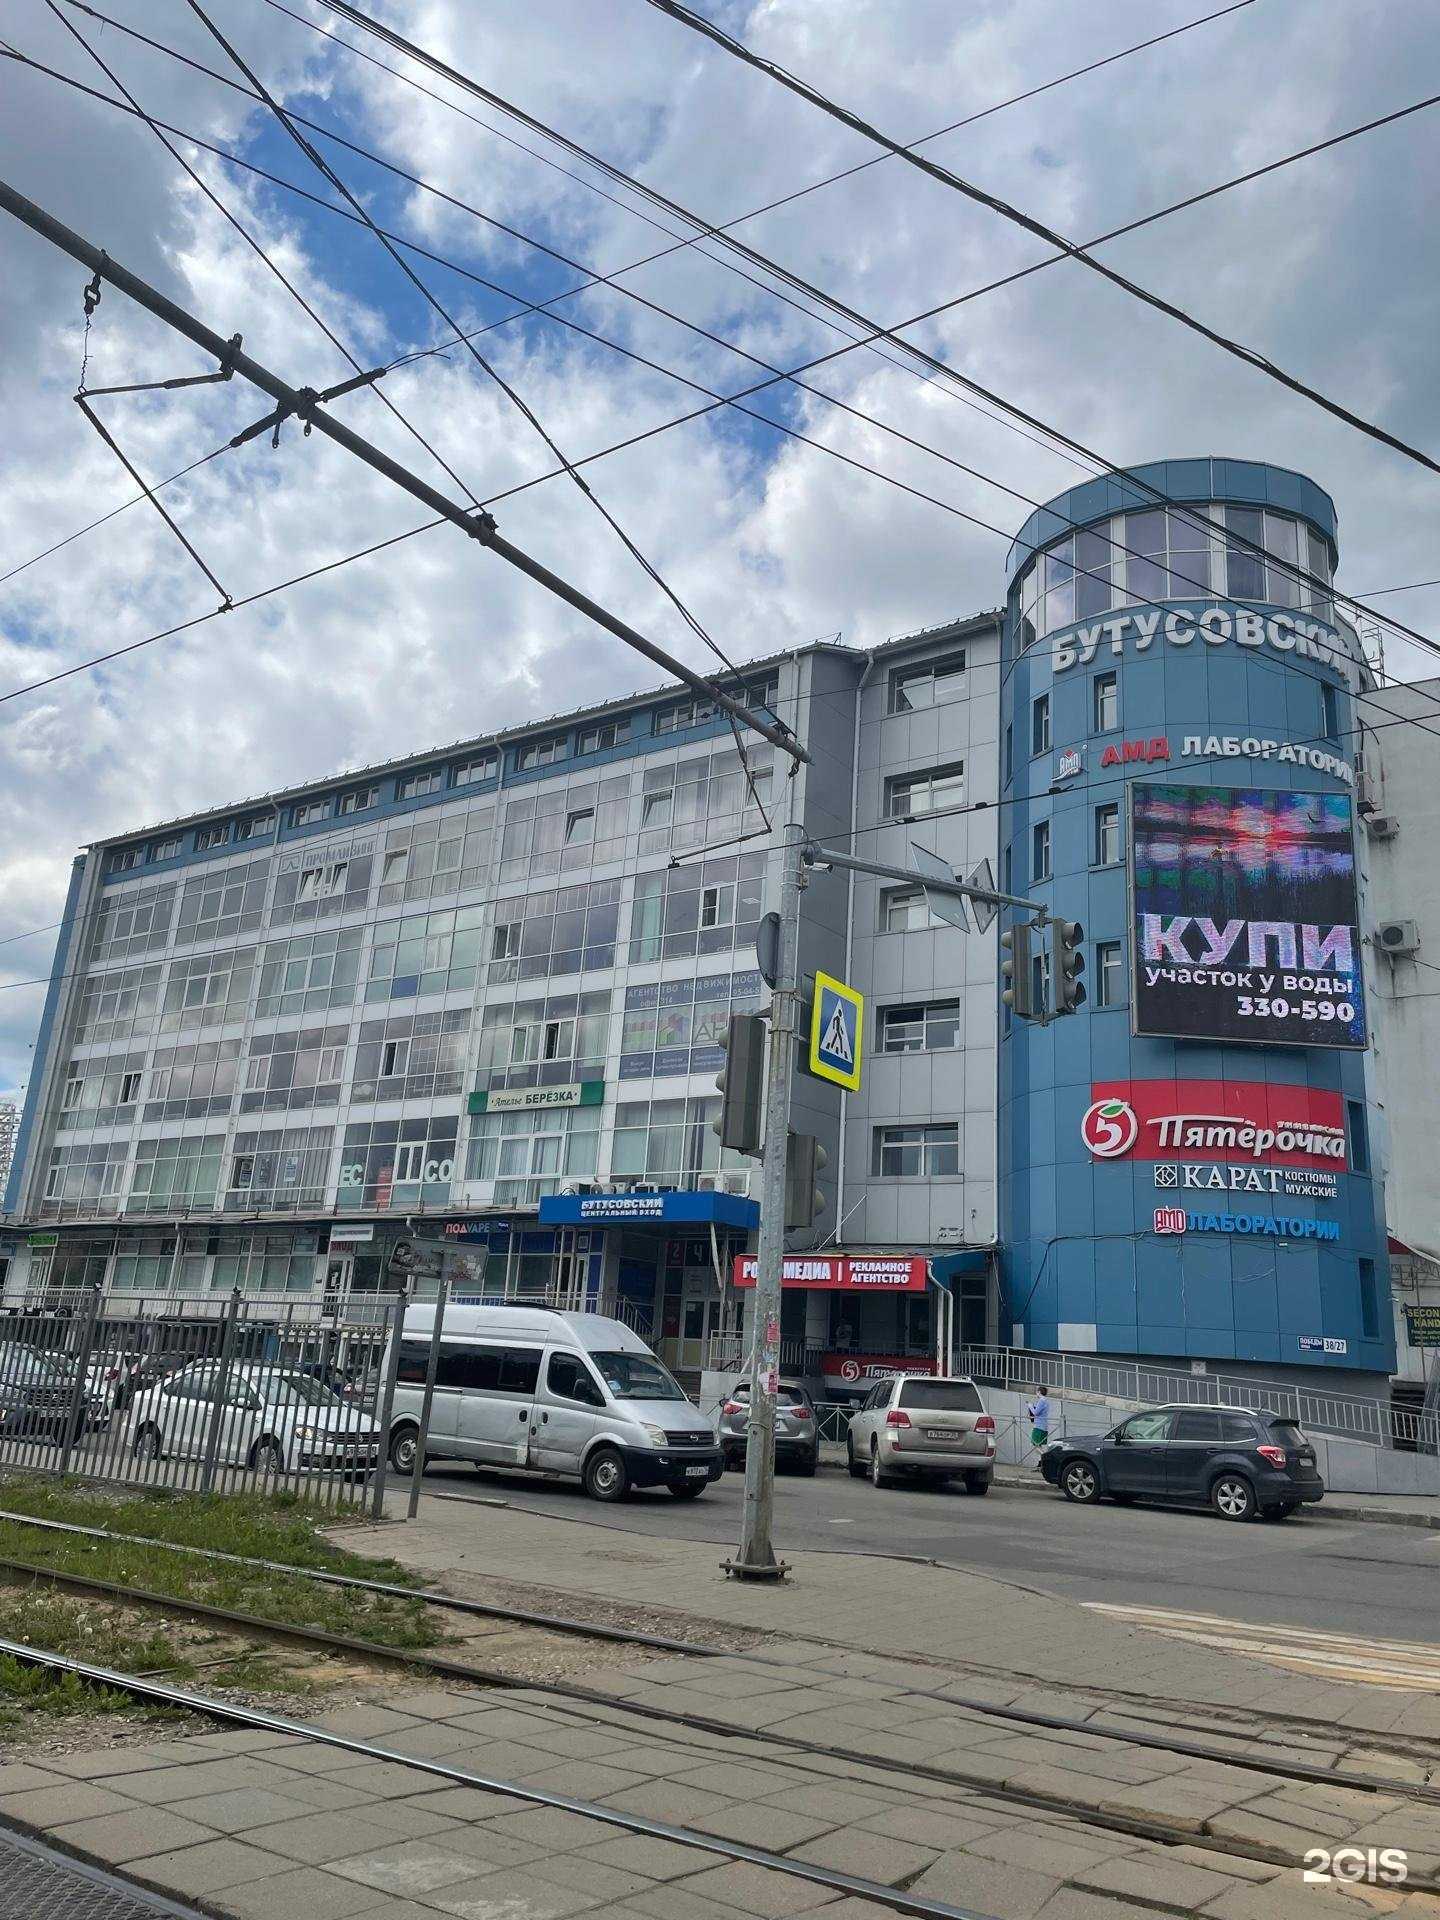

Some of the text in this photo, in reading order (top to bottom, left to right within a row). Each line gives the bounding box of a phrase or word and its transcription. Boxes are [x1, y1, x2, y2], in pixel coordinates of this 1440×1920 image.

[1101, 736, 1171, 767] АМД
[1143, 914, 1352, 972] КУПИ
[1145, 965, 1353, 995] участок у воды
[1237, 996, 1356, 1024] 330-590
[1147, 1114, 1346, 1158] Пятёрочка
[1182, 1165, 1283, 1193] КАРАТ
[1284, 1171, 1337, 1185] КОСТЮМЫ
[1285, 1185, 1338, 1198] МУЖСКИЕ
[581, 1198, 664, 1210] БУТУСОВСКИЙ
[1188, 1211, 1340, 1241] ЛАБОРАТОРИИ
[849, 1262, 912, 1273] РЕКЛАМНОЕ
[850, 1273, 909, 1284] АГЕНТСТВО
[1407, 1308, 1440, 1318] SECON
